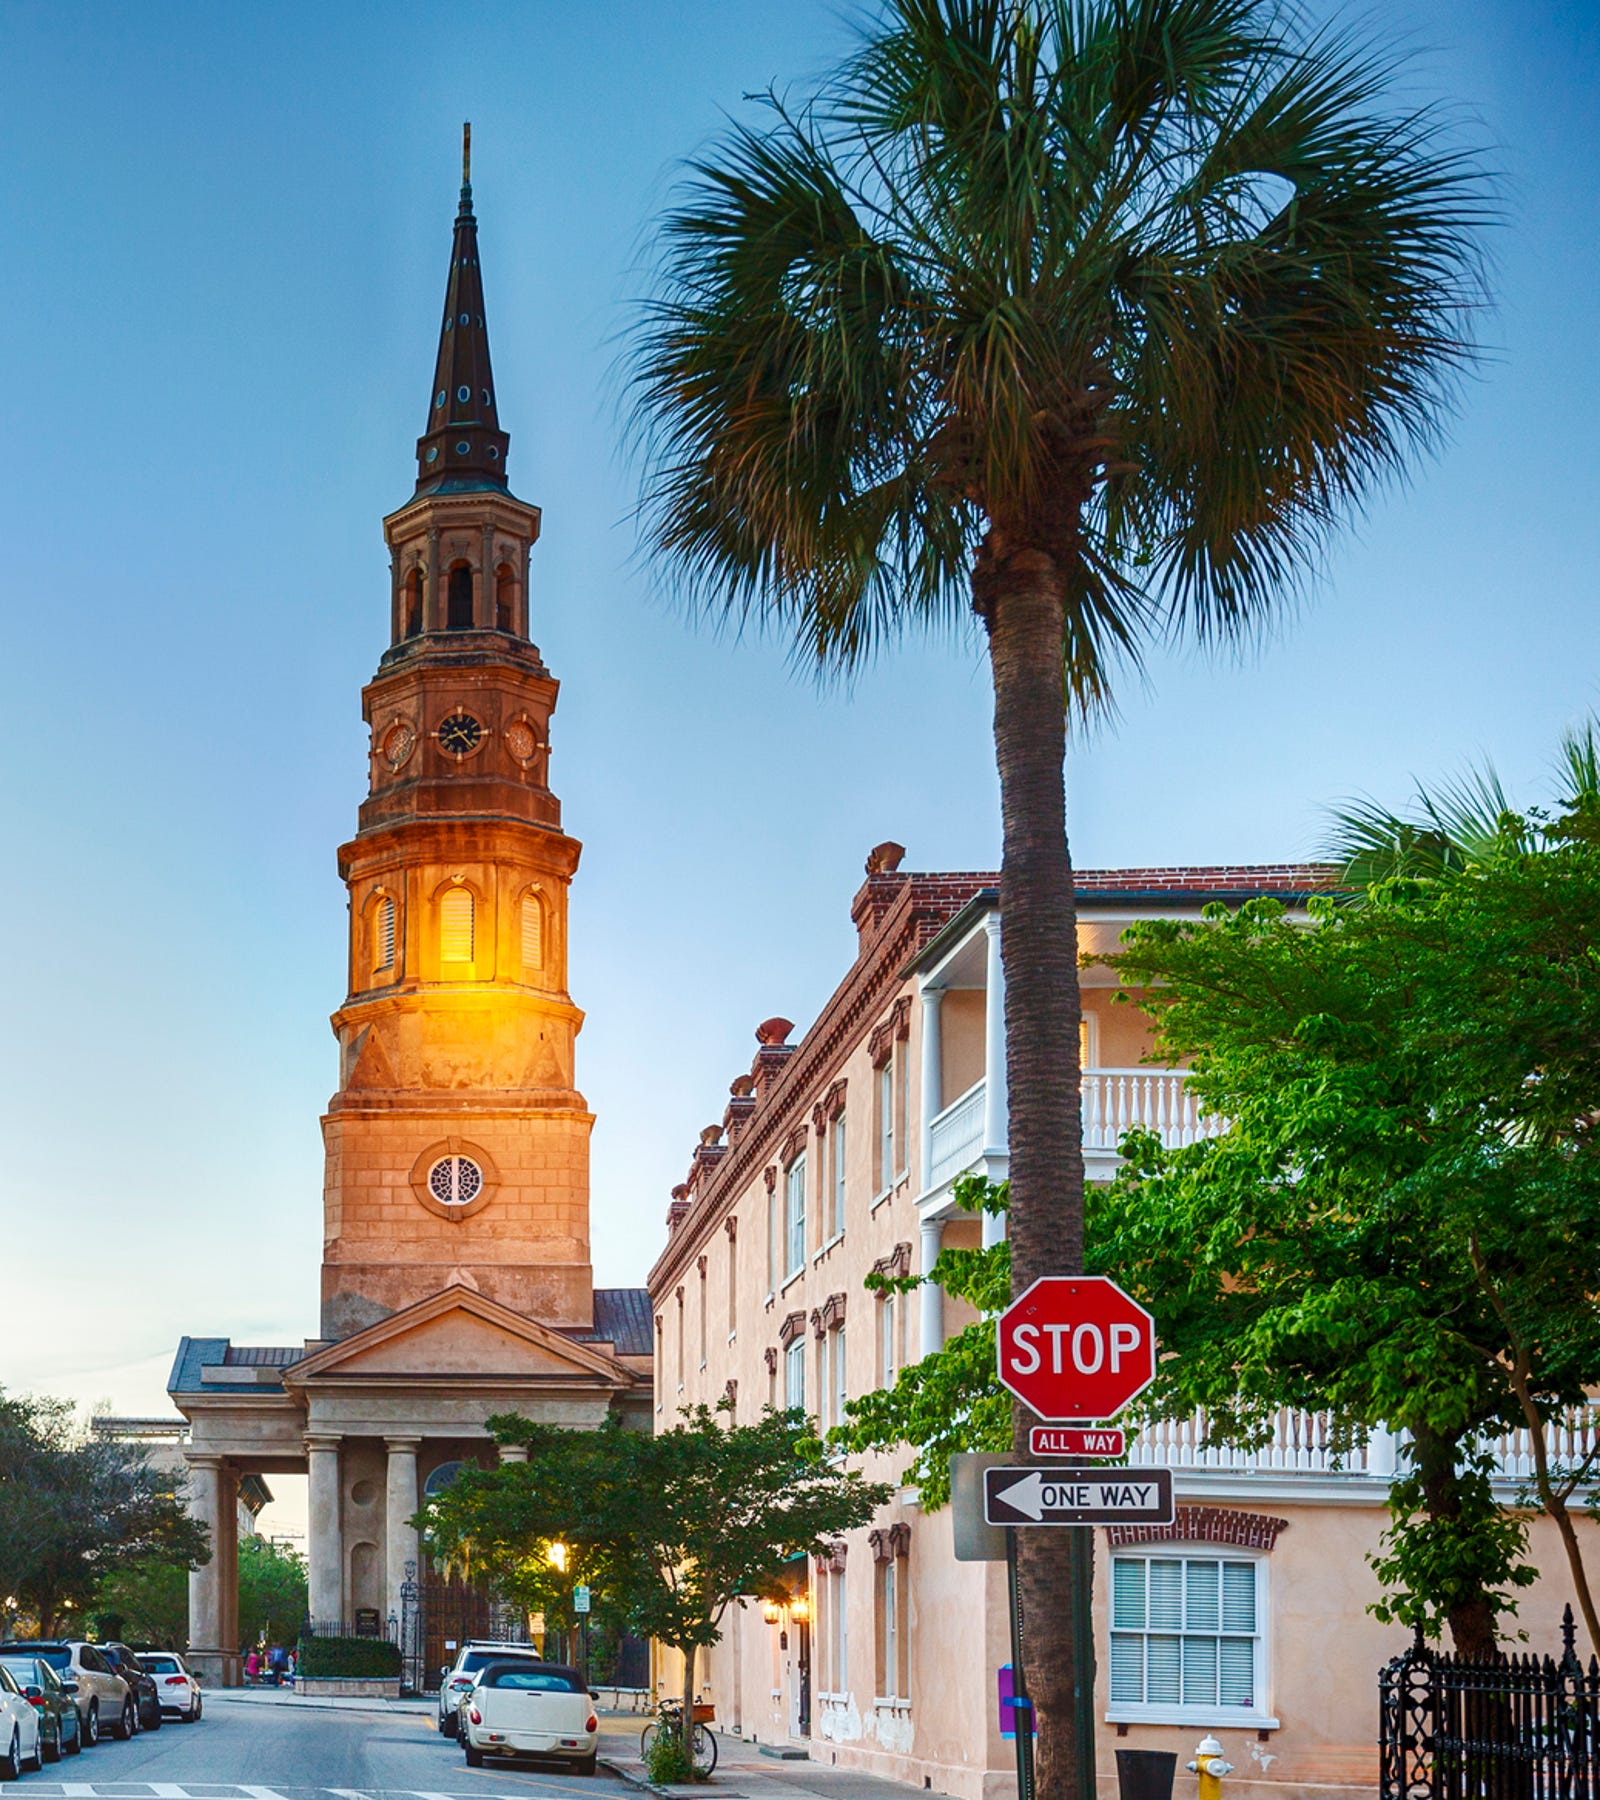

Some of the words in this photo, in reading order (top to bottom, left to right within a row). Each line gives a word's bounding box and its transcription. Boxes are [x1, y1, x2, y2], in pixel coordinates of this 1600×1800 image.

[1010, 1322, 1142, 1375] STOP
[1038, 1433, 1070, 1450] ALL
[1083, 1434, 1117, 1451] WAY
[1041, 1485, 1091, 1507] ONE
[1100, 1485, 1152, 1507] WAY
